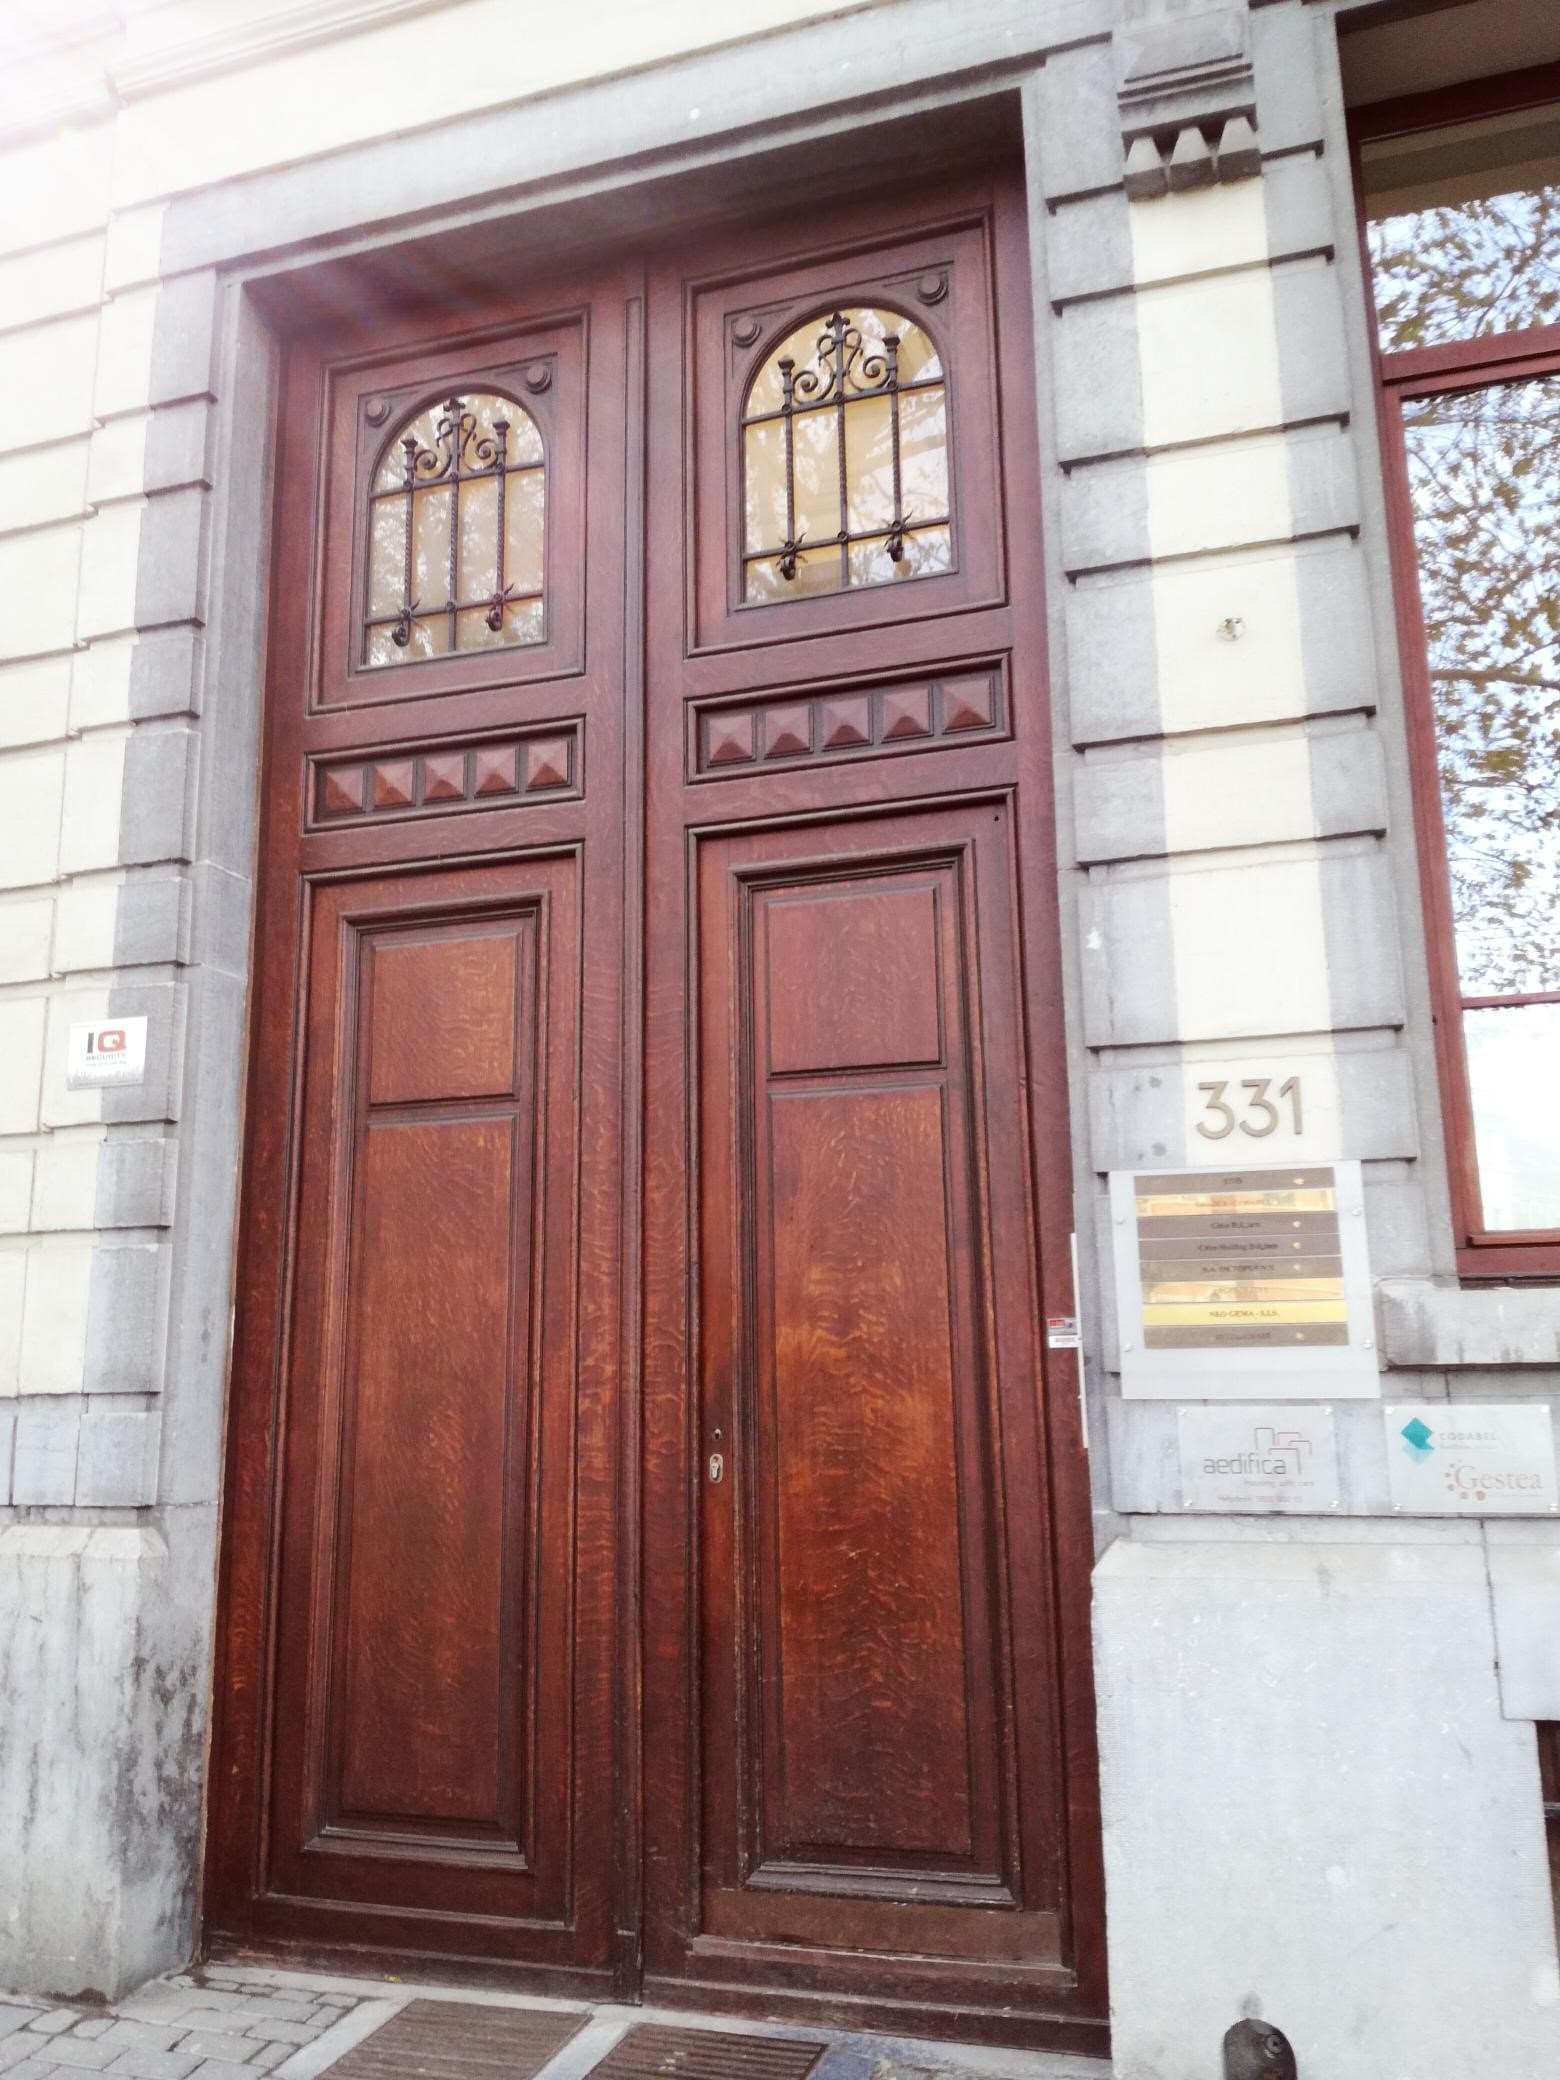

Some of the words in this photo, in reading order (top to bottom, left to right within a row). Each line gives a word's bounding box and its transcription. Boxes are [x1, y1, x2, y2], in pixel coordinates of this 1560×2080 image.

[87, 1029, 126, 1054] IQ
[1195, 1075, 1304, 1140] 331
[1203, 1452, 1287, 1475] aedifica
[1455, 1465, 1544, 1490] Gestea
